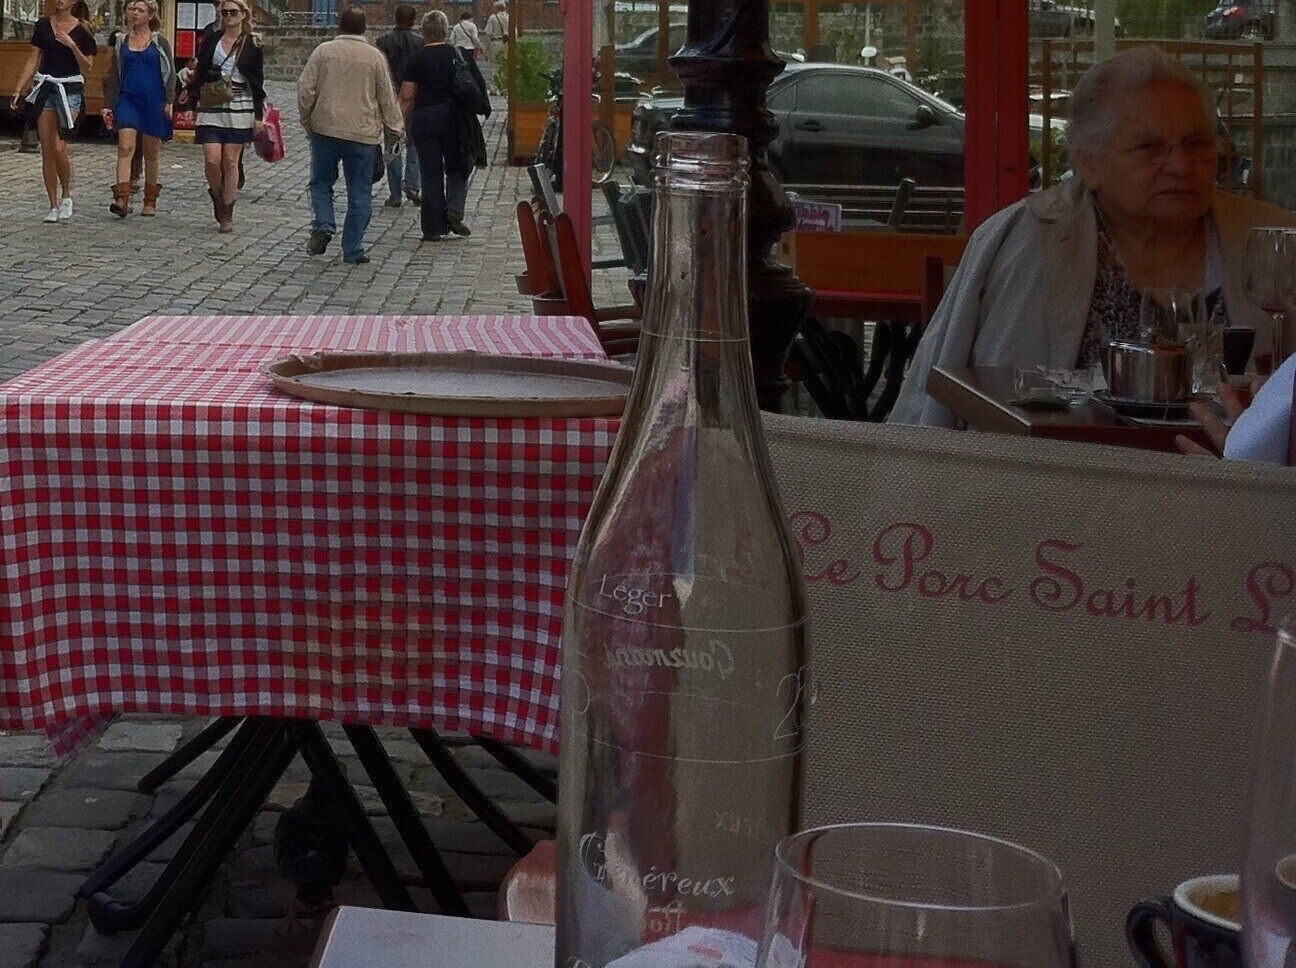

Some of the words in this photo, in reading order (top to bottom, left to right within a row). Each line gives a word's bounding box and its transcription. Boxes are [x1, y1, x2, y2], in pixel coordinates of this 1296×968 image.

[599, 574, 672, 615] Léger
[872, 522, 1013, 605] Porc
[1029, 538, 1212, 628] Saint
